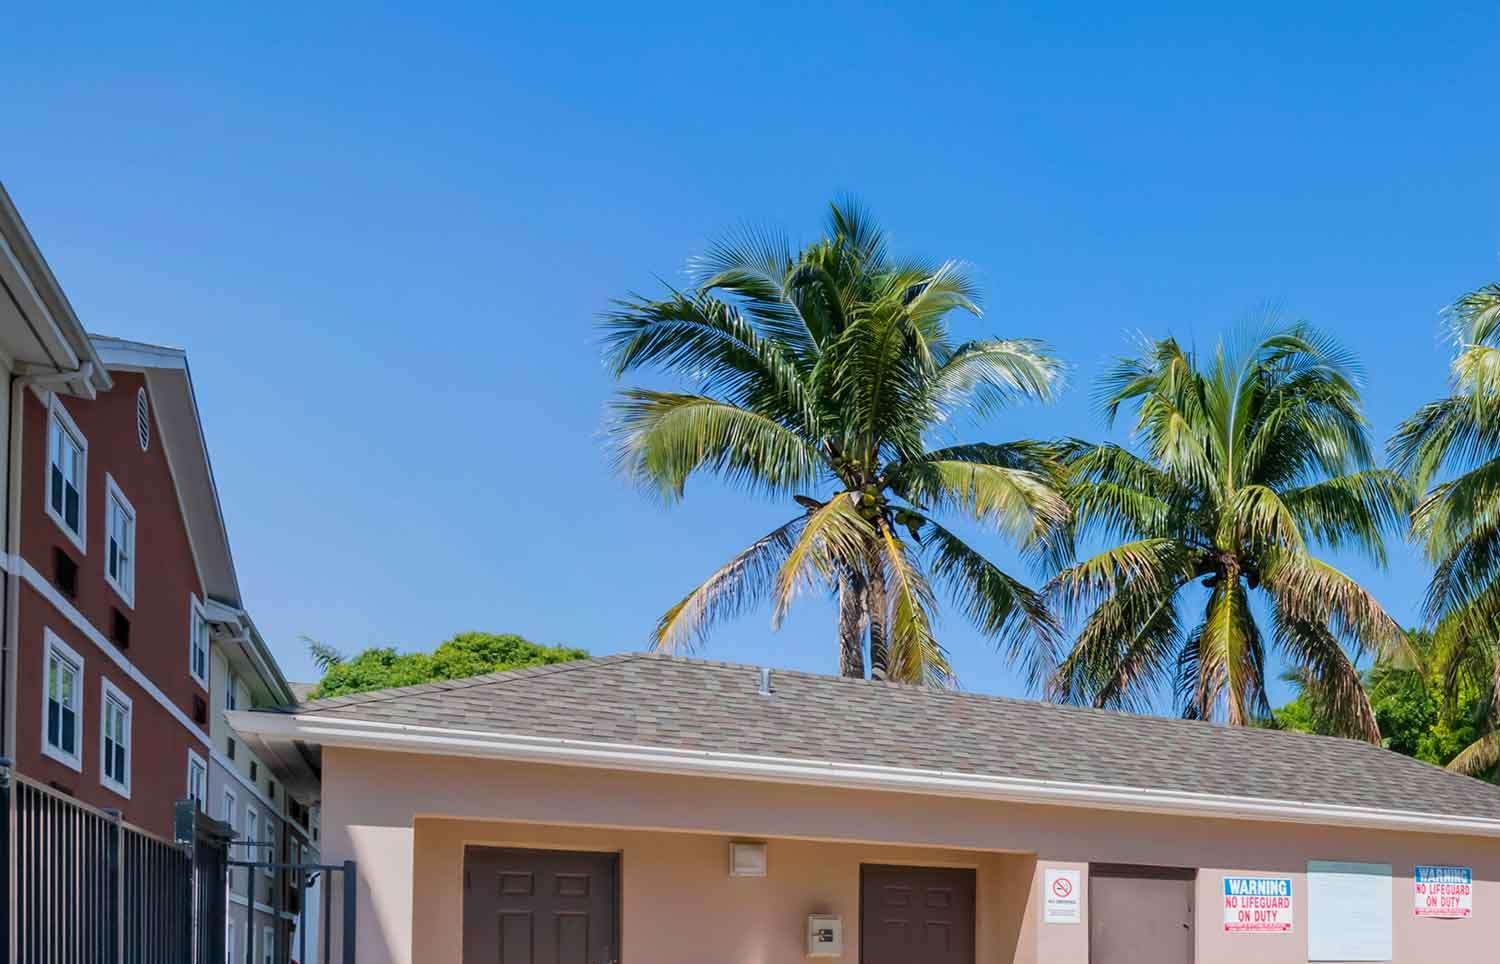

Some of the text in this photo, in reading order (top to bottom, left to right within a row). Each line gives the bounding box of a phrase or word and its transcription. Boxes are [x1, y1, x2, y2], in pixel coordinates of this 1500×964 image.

[1229, 879, 1287, 896] WARNING
[1416, 884, 1470, 895] NO LIFEGUARD
[1225, 896, 1290, 909] NO LIFEGUARD
[1426, 896, 1460, 908] ON DUTY
[1238, 910, 1278, 922] ON DUTY
